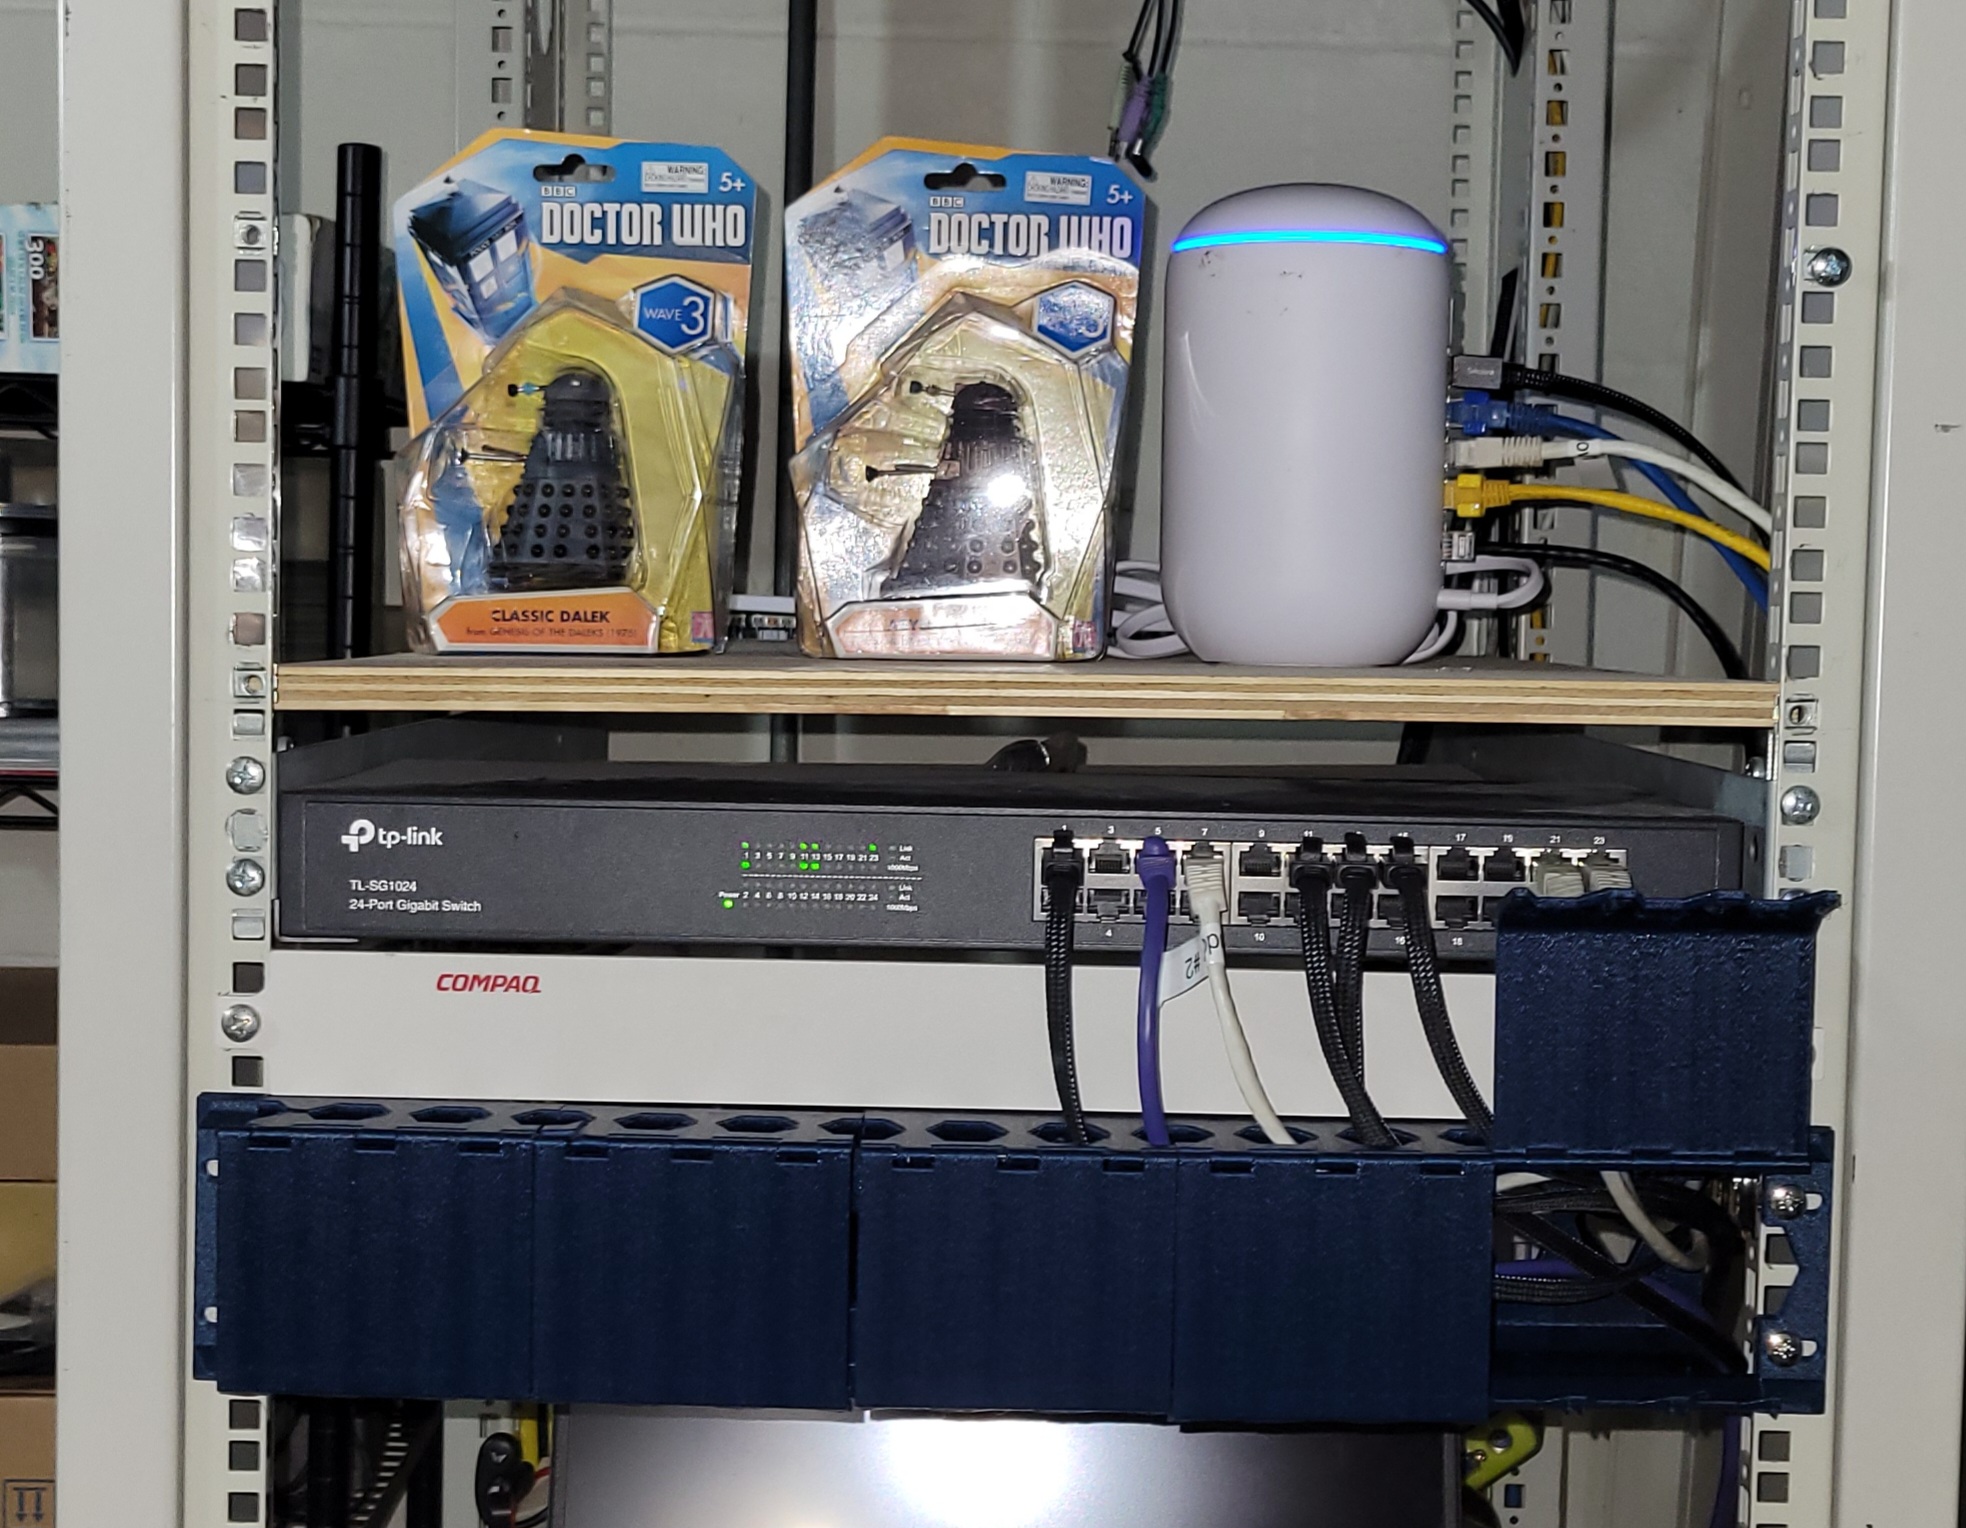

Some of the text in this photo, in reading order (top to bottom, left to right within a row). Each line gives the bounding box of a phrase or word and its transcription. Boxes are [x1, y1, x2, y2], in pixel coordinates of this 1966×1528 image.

[541, 186, 576, 197] BBC
[719, 172, 746, 192] 5+
[1106, 184, 1133, 205] 5+
[540, 202, 747, 248] DOCTOR WHO
[929, 212, 1133, 258] DOCTOR WHO
[25, 238, 45, 280] 300
[644, 296, 706, 336] WAVE 3
[492, 610, 611, 623] CLASSIC DALEK
[533, 627, 546, 637] OF
[550, 627, 566, 637] THE
[378, 826, 443, 849] tp-link
[1107, 825, 1115, 834] 3
[1155, 827, 1162, 836] 5
[1202, 828, 1209, 836] 7
[1258, 829, 1266, 838] 9
[1455, 833, 1467, 842] 17
[1503, 834, 1514, 843] 19
[1549, 835, 1561, 844] 21
[1593, 836, 1606, 845] 23
[743, 852, 749, 860] 1
[766, 852, 773, 860] 5
[778, 852, 784, 860] 7
[789, 852, 796, 860] 9
[800, 852, 809, 860] 11
[823, 853, 833, 861] 15
[834, 853, 844, 861] 17
[858, 853, 867, 861] 21
[868, 853, 879, 861] 23
[349, 880, 417, 892] TL-SG1024
[742, 891, 749, 899] 2
[754, 891, 761, 899] 4
[787, 893, 797, 901] 10
[800, 893, 809, 901] 12
[811, 893, 820, 901] 14
[845, 893, 856, 901] 20
[857, 893, 867, 901] 22
[868, 893, 879, 901] 24
[349, 899, 482, 914] 24-Port Gigabit Switch
[1105, 929, 1113, 937] 4
[1253, 932, 1265, 942] 10
[1452, 937, 1463, 946] 18
[436, 973, 542, 994] COMPAQ
